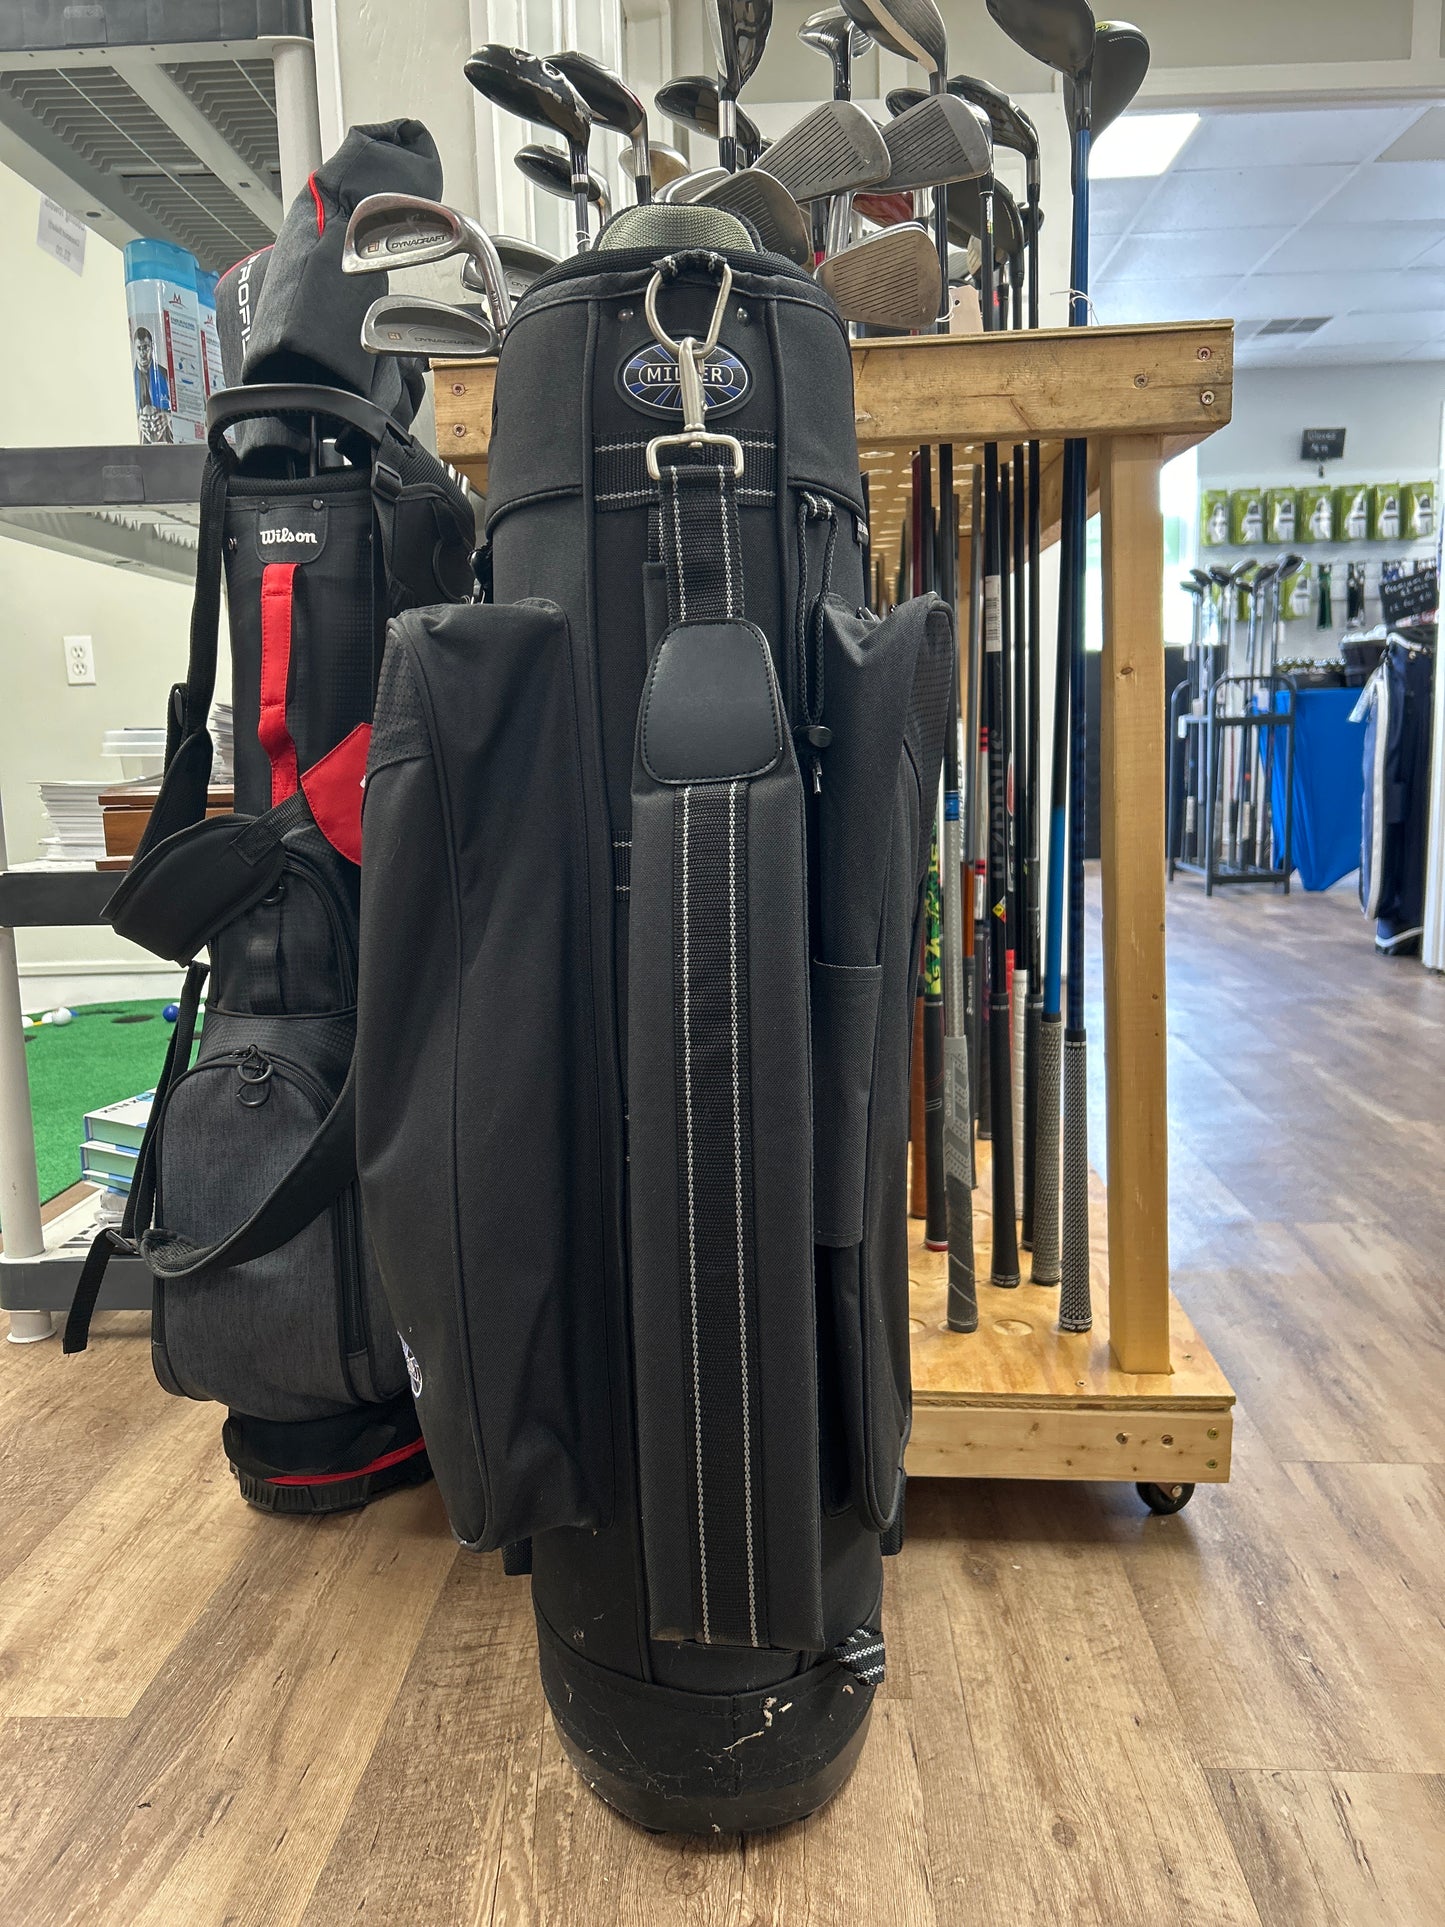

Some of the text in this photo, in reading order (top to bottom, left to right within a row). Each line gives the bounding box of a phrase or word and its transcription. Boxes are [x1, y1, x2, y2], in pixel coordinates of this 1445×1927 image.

[391, 234, 447, 249] DYNACRAFT
[647, 367, 723, 382] MILER
[260, 527, 318, 545] Wilson
